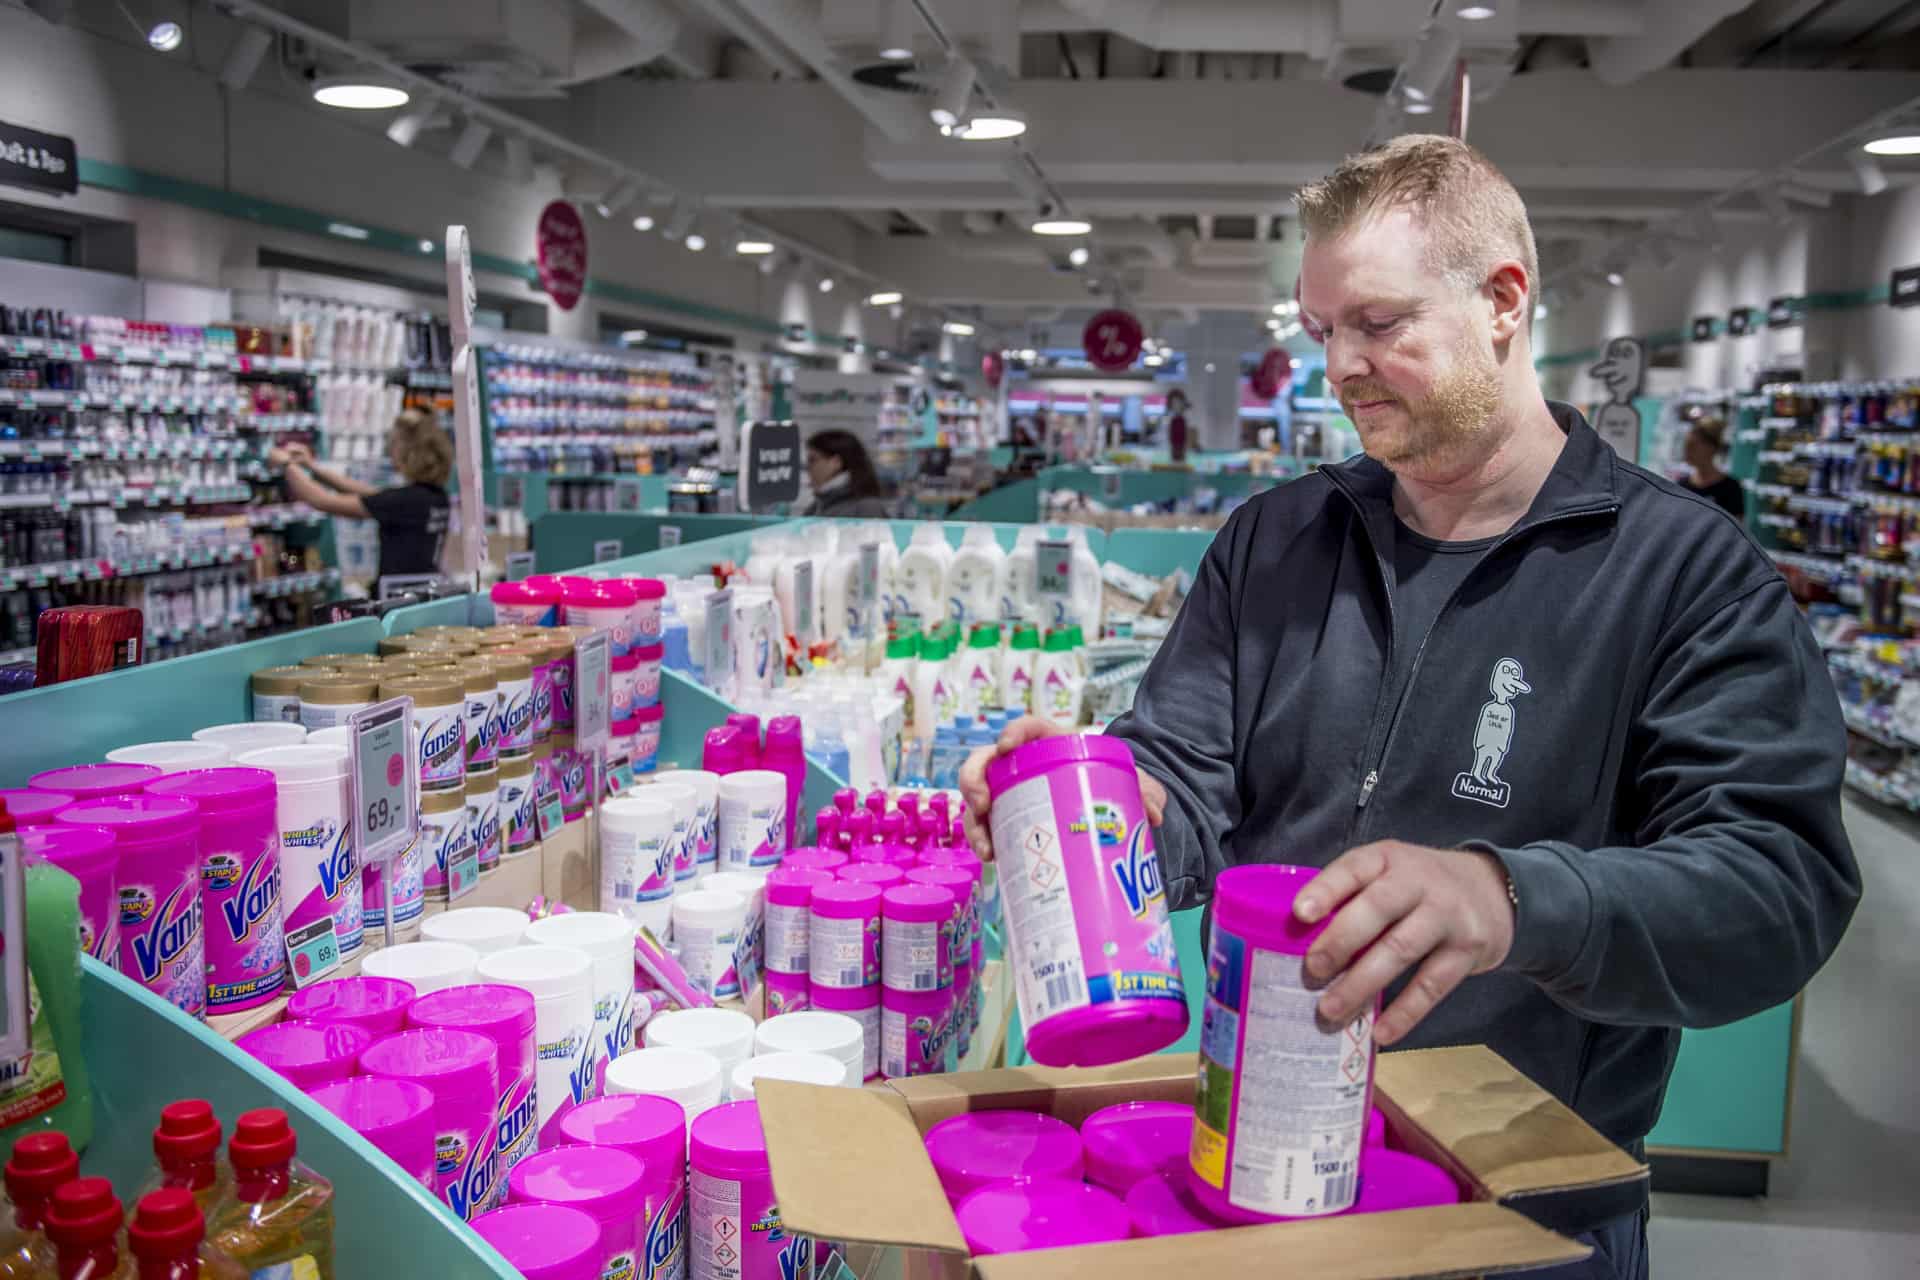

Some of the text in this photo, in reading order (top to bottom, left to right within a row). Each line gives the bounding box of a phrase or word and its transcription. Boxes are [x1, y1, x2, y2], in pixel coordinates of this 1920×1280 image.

[1459, 777, 1504, 801] Normal
[367, 797, 401, 832] 69,-
[283, 830, 319, 840] WHITER
[284, 837, 320, 848] WHITES
[208, 983, 230, 998] 1ST
[231, 981, 257, 996] TIME
